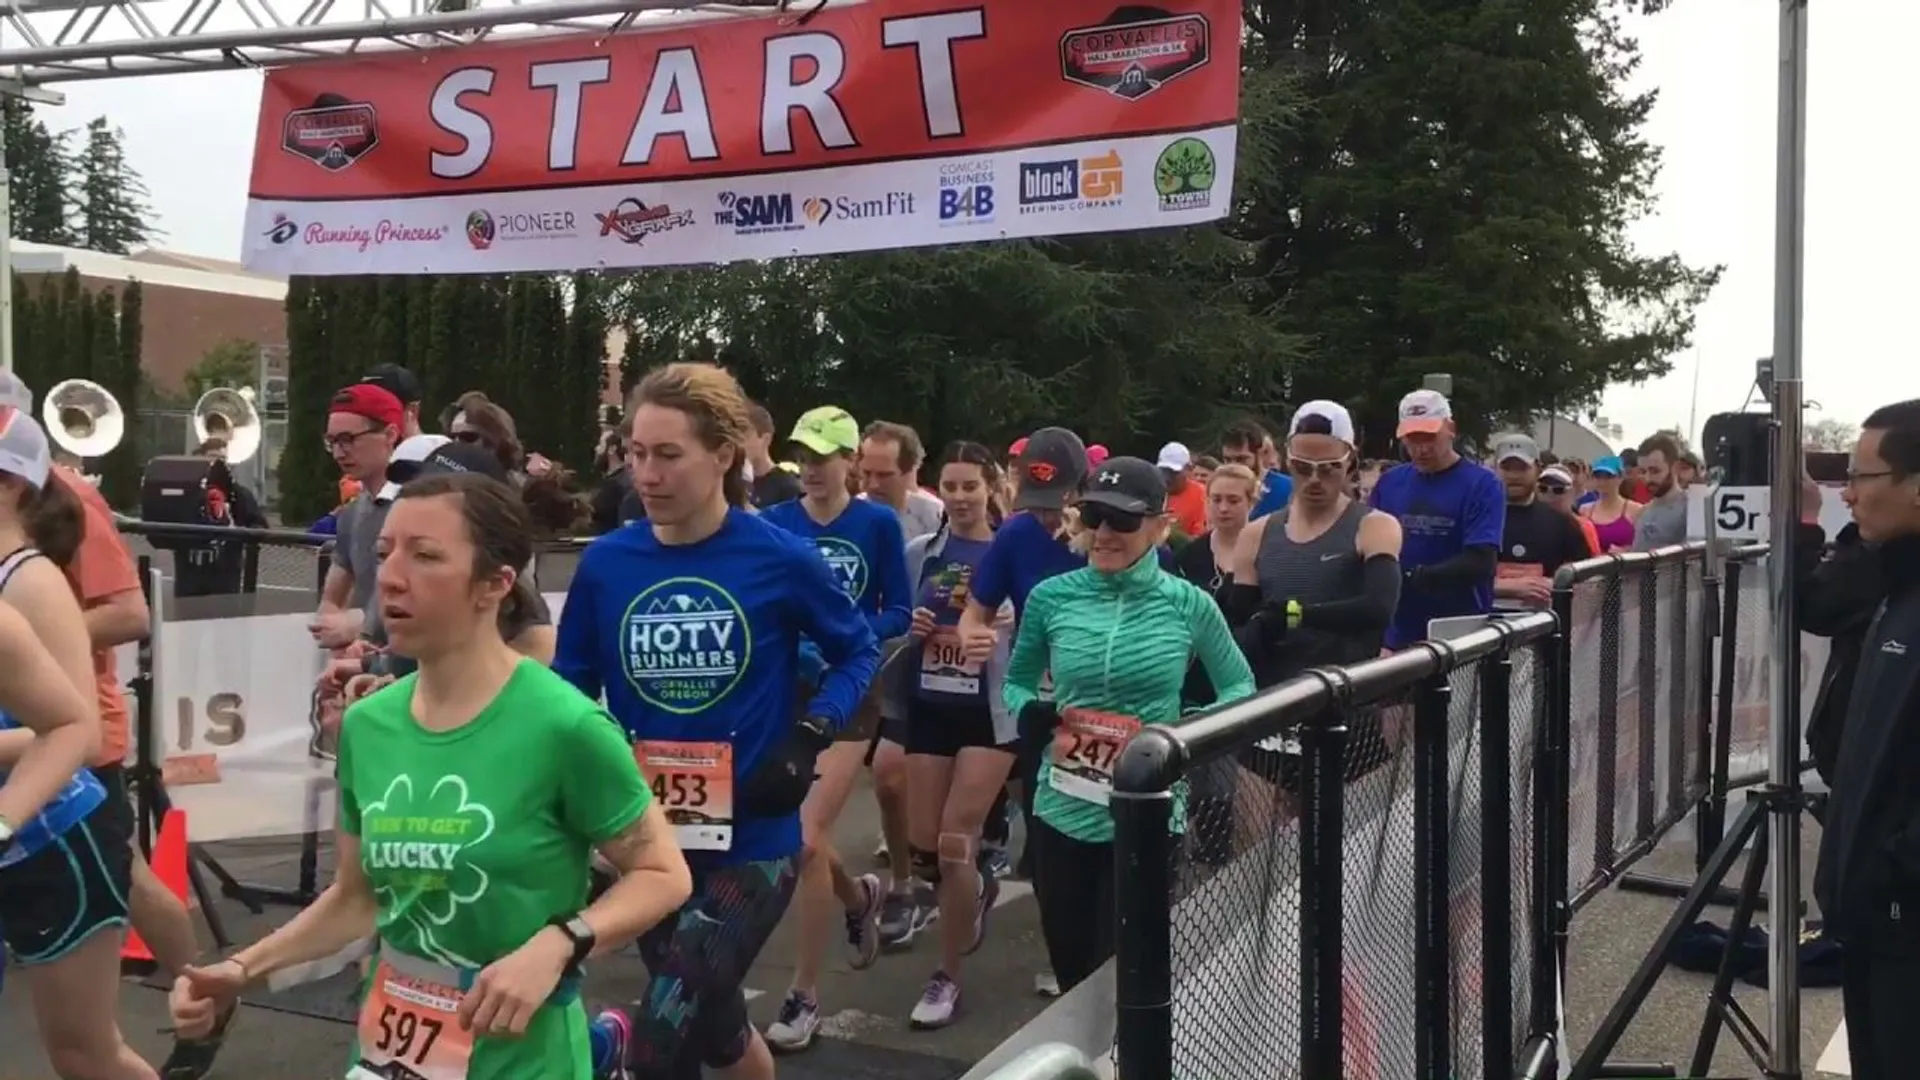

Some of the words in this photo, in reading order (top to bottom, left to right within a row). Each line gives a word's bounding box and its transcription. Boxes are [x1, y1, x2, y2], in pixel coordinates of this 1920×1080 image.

[1070, 22, 1198, 52] CORVALLIS
[429, 6, 987, 180] START
[939, 160, 994, 175] COMCAST
[939, 172, 994, 186] BUSINESS
[1024, 165, 1074, 199] block
[714, 211, 735, 226] THE
[735, 192, 794, 227] SAM
[836, 192, 916, 220] SamFit
[939, 185, 995, 219] B4B
[1019, 203, 1065, 215] BREWING
[1069, 200, 1123, 212] COMPANY
[303, 221, 371, 252] Running
[500, 210, 576, 233] PIONEER
[630, 621, 734, 653] HOTV
[630, 650, 737, 669] RUNNERS
[1066, 733, 1119, 770] 247
[651, 773, 708, 807] 453
[430, 818, 472, 835] GET
[369, 842, 462, 870] LUCKY
[376, 1003, 443, 1065] 597
